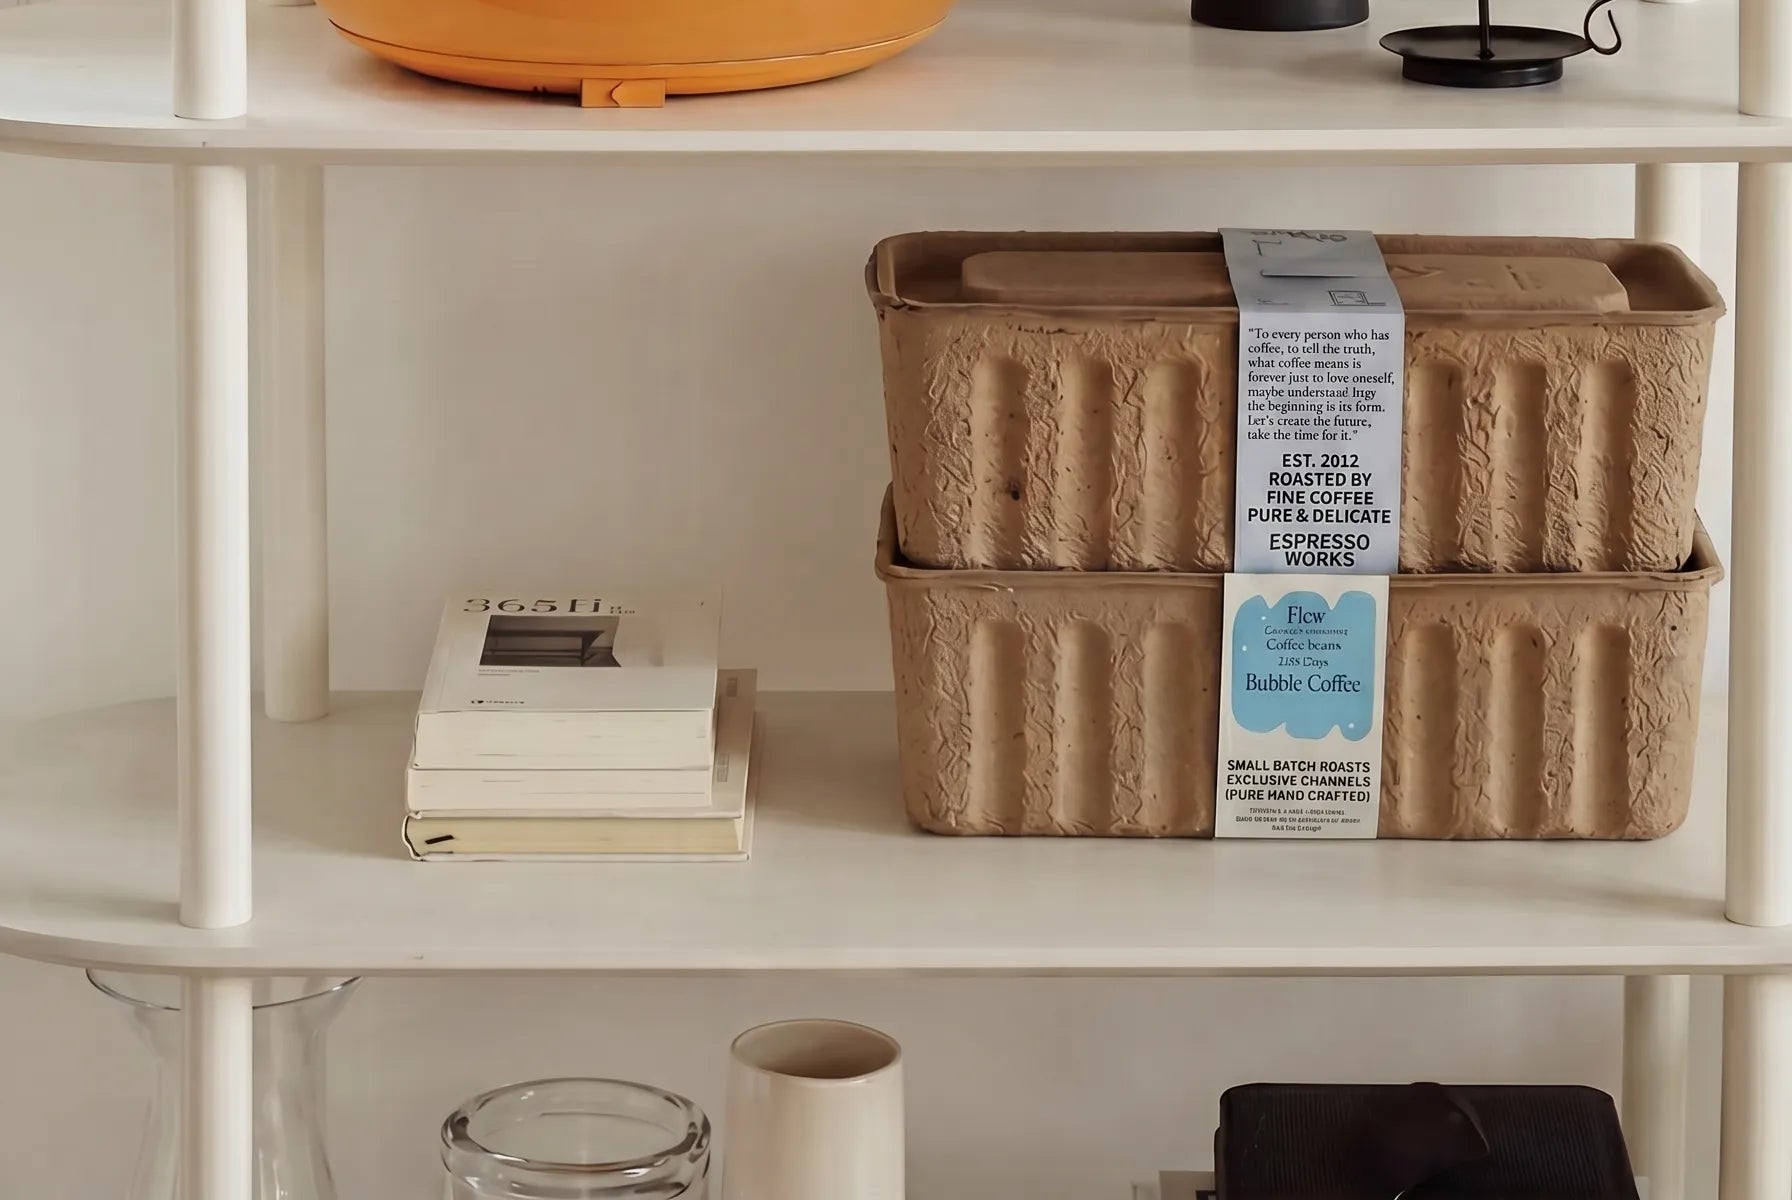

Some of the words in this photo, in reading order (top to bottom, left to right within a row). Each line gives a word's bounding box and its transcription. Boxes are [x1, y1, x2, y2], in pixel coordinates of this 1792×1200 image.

[1271, 331, 1301, 342] every
[1304, 330, 1341, 343] person
[1344, 328, 1368, 340] who
[1371, 329, 1390, 341] has
[1247, 343, 1284, 355] coffee,
[1287, 345, 1299, 354] to
[1302, 343, 1319, 354] tell
[1322, 343, 1340, 354] the
[1343, 343, 1375, 356] truth,
[1247, 357, 1275, 368] what
[1278, 357, 1311, 369] coffee
[1314, 359, 1349, 369] means
[1352, 358, 1362, 369] is
[1247, 371, 1286, 383] forever
[1288, 372, 1309, 385] just
[1312, 374, 1324, 383] to
[1327, 371, 1349, 383] love
[1352, 372, 1395, 385] oneself,
[1247, 386, 1284, 402] maybe
[1247, 400, 1265, 412] the
[1268, 400, 1323, 414] beginning
[1326, 401, 1336, 412] is
[1339, 401, 1352, 412] its
[1355, 401, 1386, 412] form.
[1277, 416, 1310, 426] create
[1313, 415, 1331, 427] the
[1333, 415, 1372, 428] future,
[1247, 428, 1270, 440] take
[1273, 429, 1291, 440] the
[1294, 429, 1319, 440] time
[1322, 429, 1338, 440] for
[1282, 453, 1316, 468] EST.
[1320, 454, 1359, 468] 2012
[1269, 472, 1346, 486] ROASTED
[1351, 473, 1372, 486] BY
[1267, 490, 1306, 504] FINE
[1309, 491, 1374, 505] COFFEE
[1248, 508, 1293, 522] PURE
[1296, 508, 1309, 523] &
[1313, 509, 1391, 524] DELICATE
[1269, 533, 1370, 550] ESPRESSO
[1285, 551, 1355, 567] WORKS
[1266, 638, 1305, 651] Coffee
[1308, 638, 1342, 651] beans
[1303, 656, 1329, 669] Days
[1245, 673, 1303, 692] Bubble
[1307, 674, 1361, 693] Coffee
[1227, 759, 1270, 771] SMALL
[1273, 760, 1316, 772] BATCH
[1320, 761, 1370, 773] ROASTS
[1227, 774, 1297, 786] EXCLUSIVE
[1300, 775, 1371, 787] CHANNELS
[1225, 788, 1265, 801] (PURE
[1268, 790, 1305, 801] HAND
[1307, 790, 1370, 803] CRAFTED)
